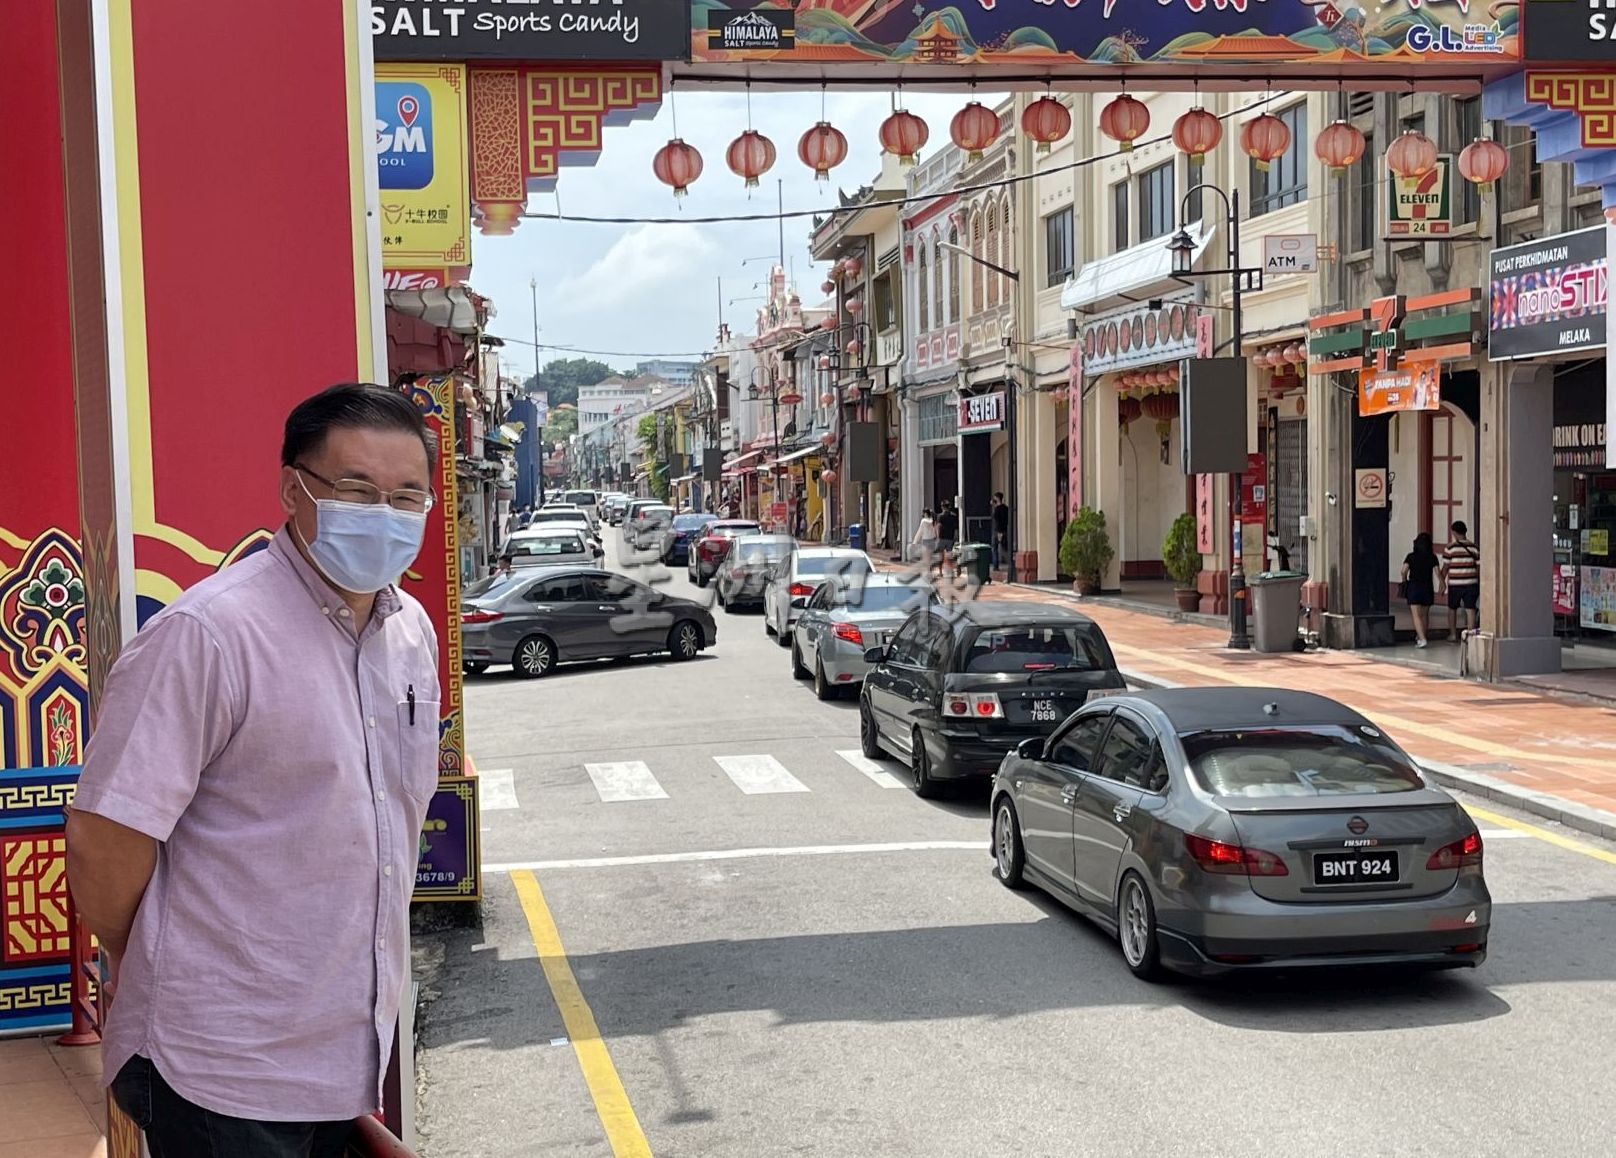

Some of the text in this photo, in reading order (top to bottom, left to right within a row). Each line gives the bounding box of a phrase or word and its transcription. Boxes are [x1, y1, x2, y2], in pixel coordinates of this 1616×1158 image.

[372, 7, 639, 42] SALT Sports Candy
[724, 26, 778, 40] HIMALAYA
[1408, 25, 1463, 51] G.L.
[1464, 32, 1495, 44] LED
[1413, 223, 1426, 232] 24
[1268, 256, 1296, 267] ATM
[1495, 246, 1568, 273] PUSAT PERKHIDMATAN
[1559, 328, 1591, 345] MELAKA
[1581, 424, 1595, 446] ON
[1033, 700, 1052, 710] NCE
[1031, 711, 1056, 721] 7868
[1322, 859, 1392, 877] BNT 924
[415, 871, 455, 882] 3678/9
